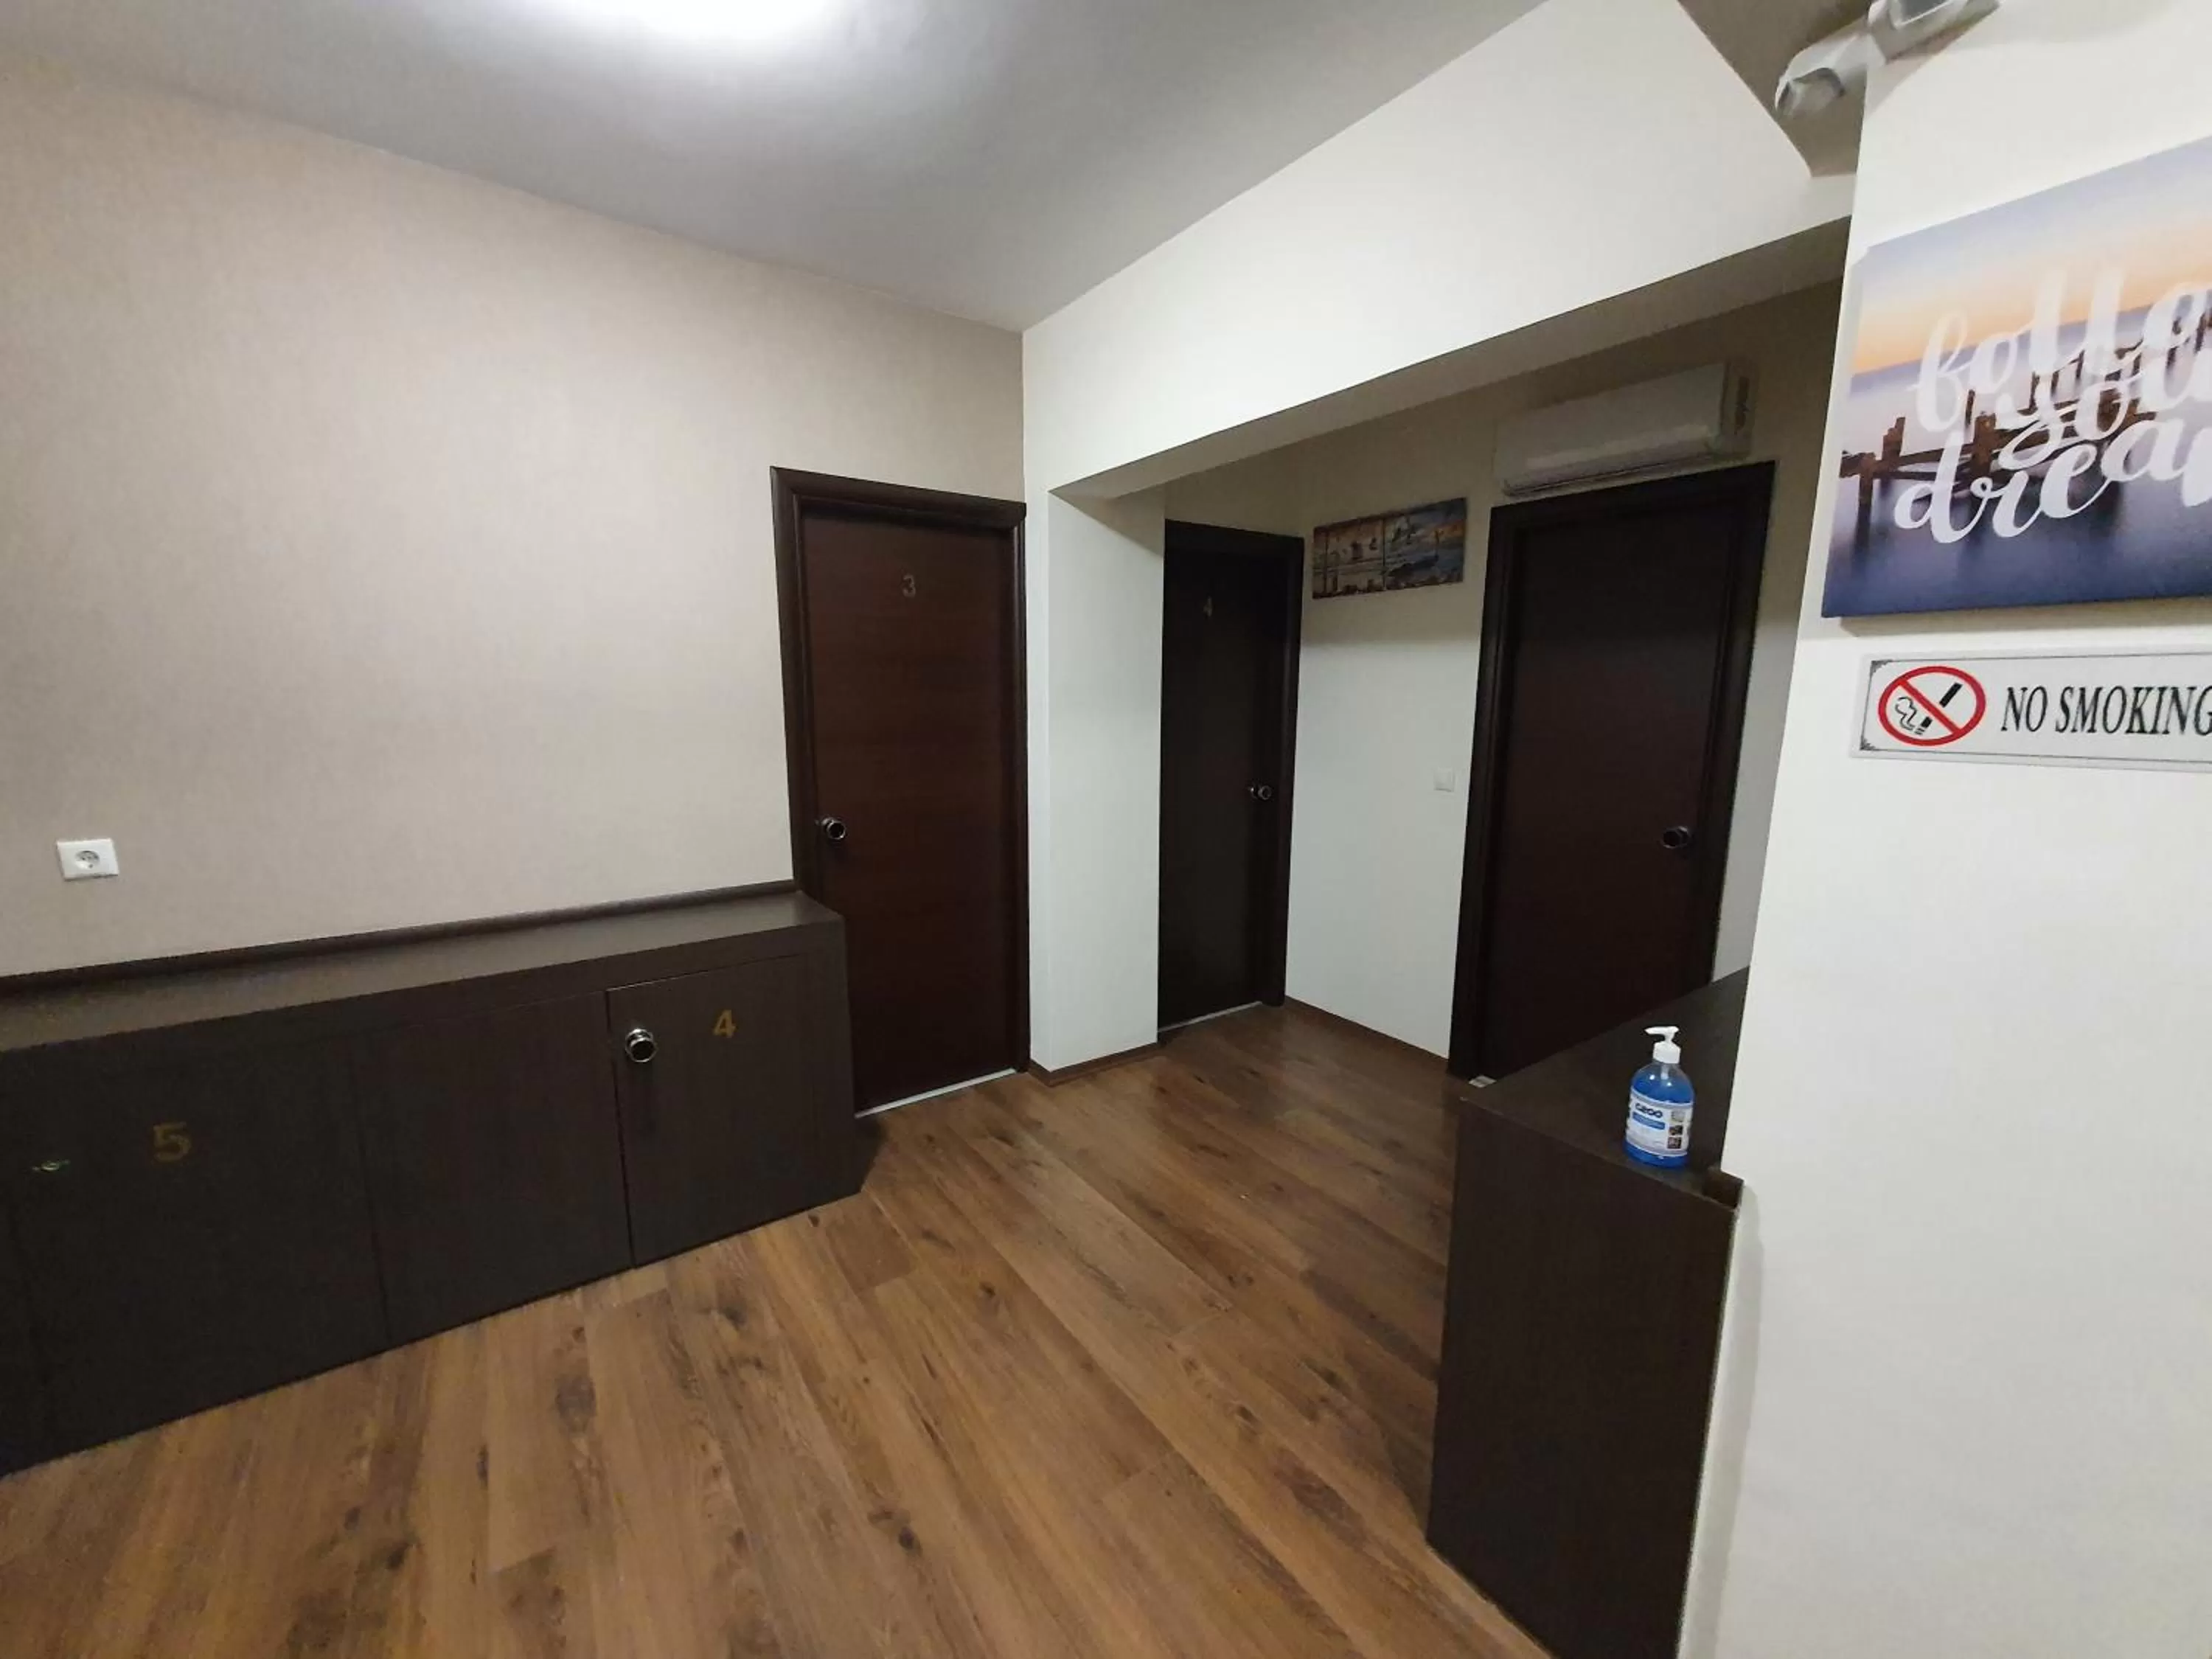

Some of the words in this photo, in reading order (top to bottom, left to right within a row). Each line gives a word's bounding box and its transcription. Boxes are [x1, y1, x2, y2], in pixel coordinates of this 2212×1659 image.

[902, 573, 917, 598] 3
[1203, 596, 1213, 618] 4
[2000, 685, 2048, 732] NO
[2054, 685, 2212, 736] SMOKING
[712, 1009, 737, 1038] 4
[152, 1121, 192, 1164] 5
